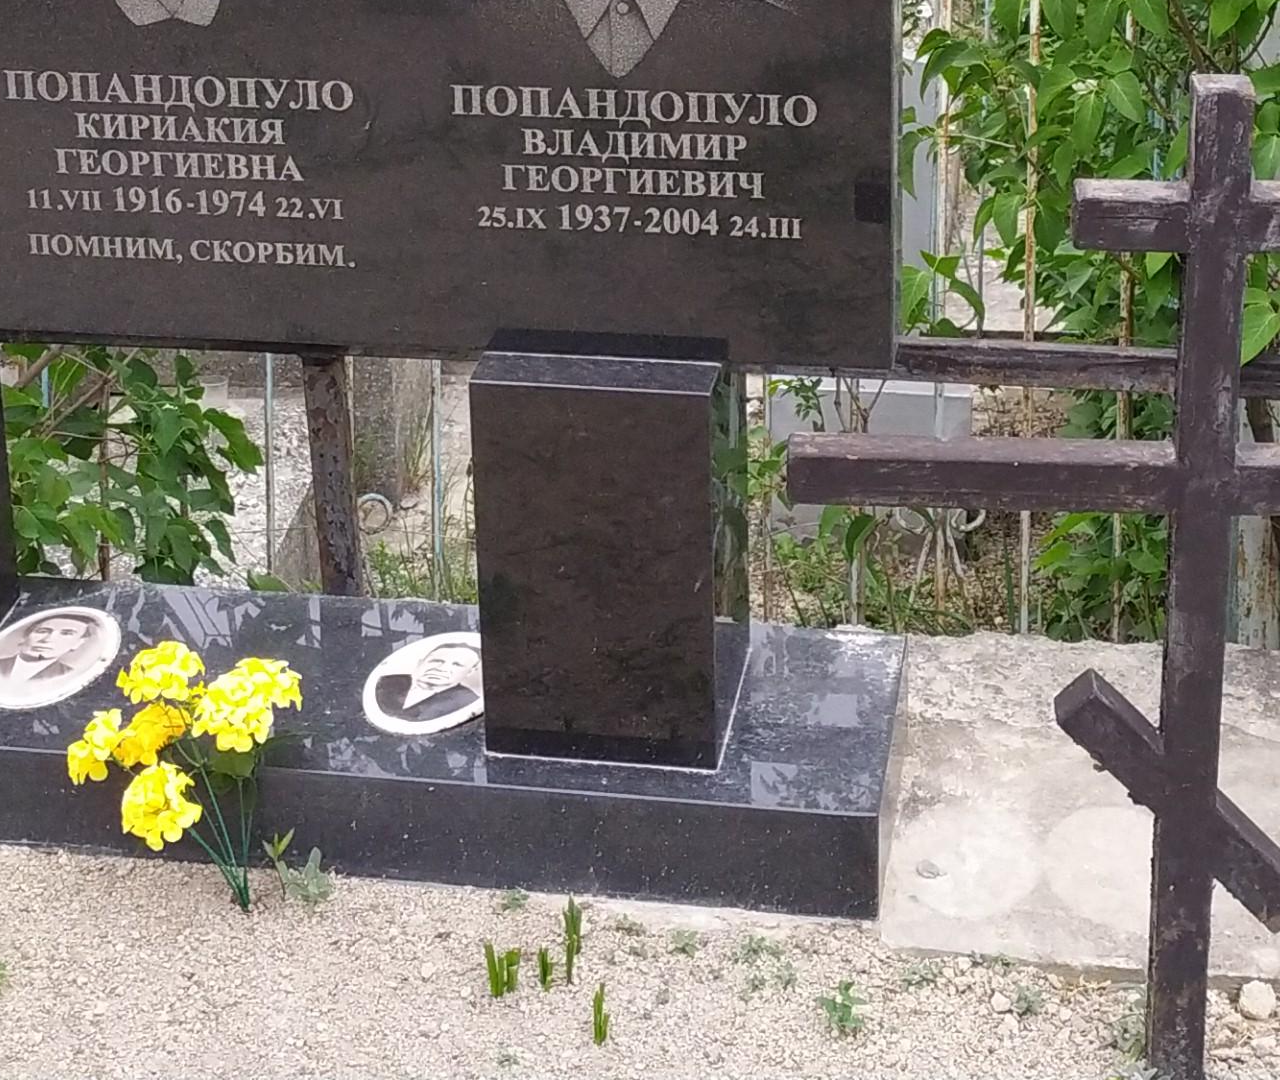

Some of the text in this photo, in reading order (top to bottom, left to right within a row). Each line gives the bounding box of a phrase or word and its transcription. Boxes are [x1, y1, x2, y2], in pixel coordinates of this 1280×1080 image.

[2, 70, 354, 112] ПОПАНДОПУЛО
[450, 84, 818, 128] ПОПАНДОПУЛО
[74, 112, 286, 146] КИРИАКИЯ
[521, 128, 747, 164] ВЛАДИМИР
[54, 148, 305, 182] ГЕОРГИЕВНА
[502, 163, 765, 199] ГЕОРГИЕВИЧ
[114, 186, 265, 217] 1916-1974
[558, 204, 719, 236] 1937-2004
[28, 233, 356, 268] ПОМНИМ, СКОРБИМ.
